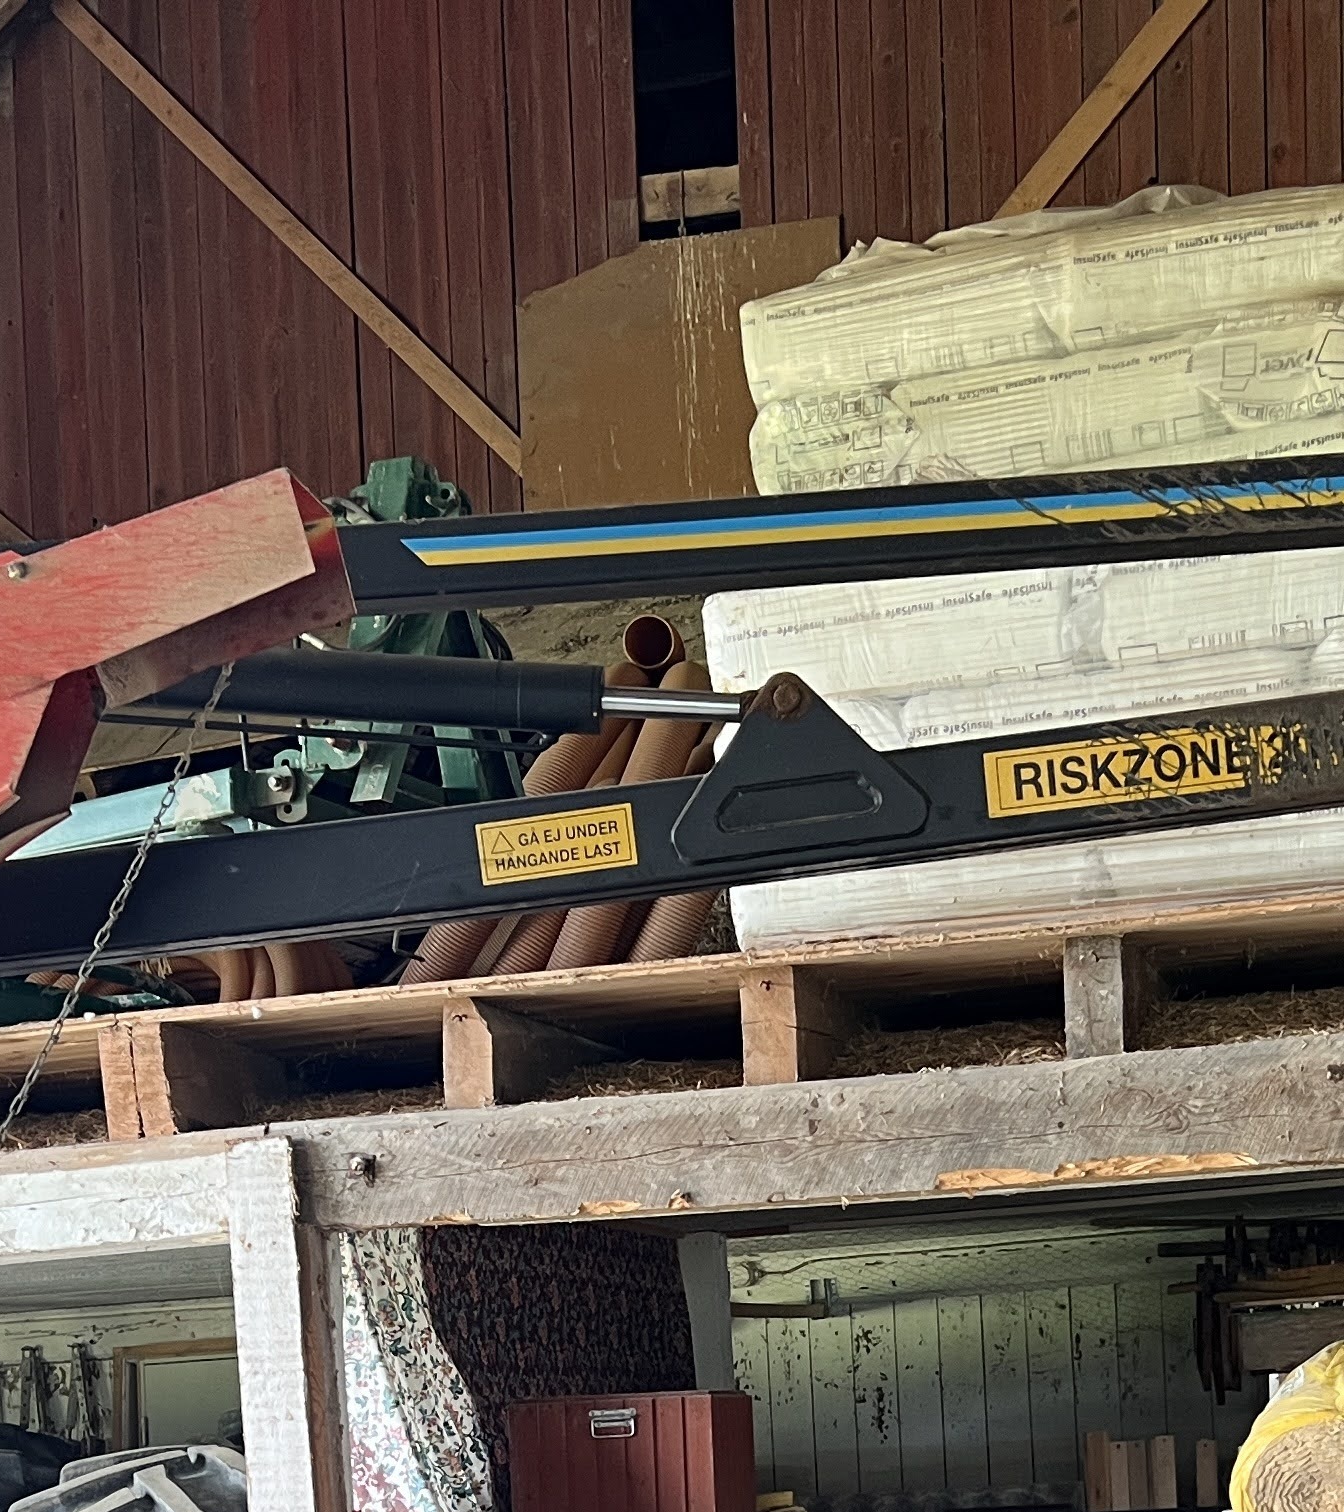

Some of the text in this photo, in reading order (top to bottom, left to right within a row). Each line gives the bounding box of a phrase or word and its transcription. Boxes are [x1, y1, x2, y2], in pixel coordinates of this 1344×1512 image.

[1302, 431, 1344, 448] InsulSafe
[885, 601, 934, 619] InsulSafe
[942, 589, 992, 609] InsulSafe
[1001, 581, 1053, 600] InsulSafe
[943, 719, 994, 736] InsulSafe
[1002, 708, 1053, 726] InsulSafe
[518, 820, 619, 847] GÅ EJ UNDER
[495, 841, 621, 872] HÄNGANDE LAST
